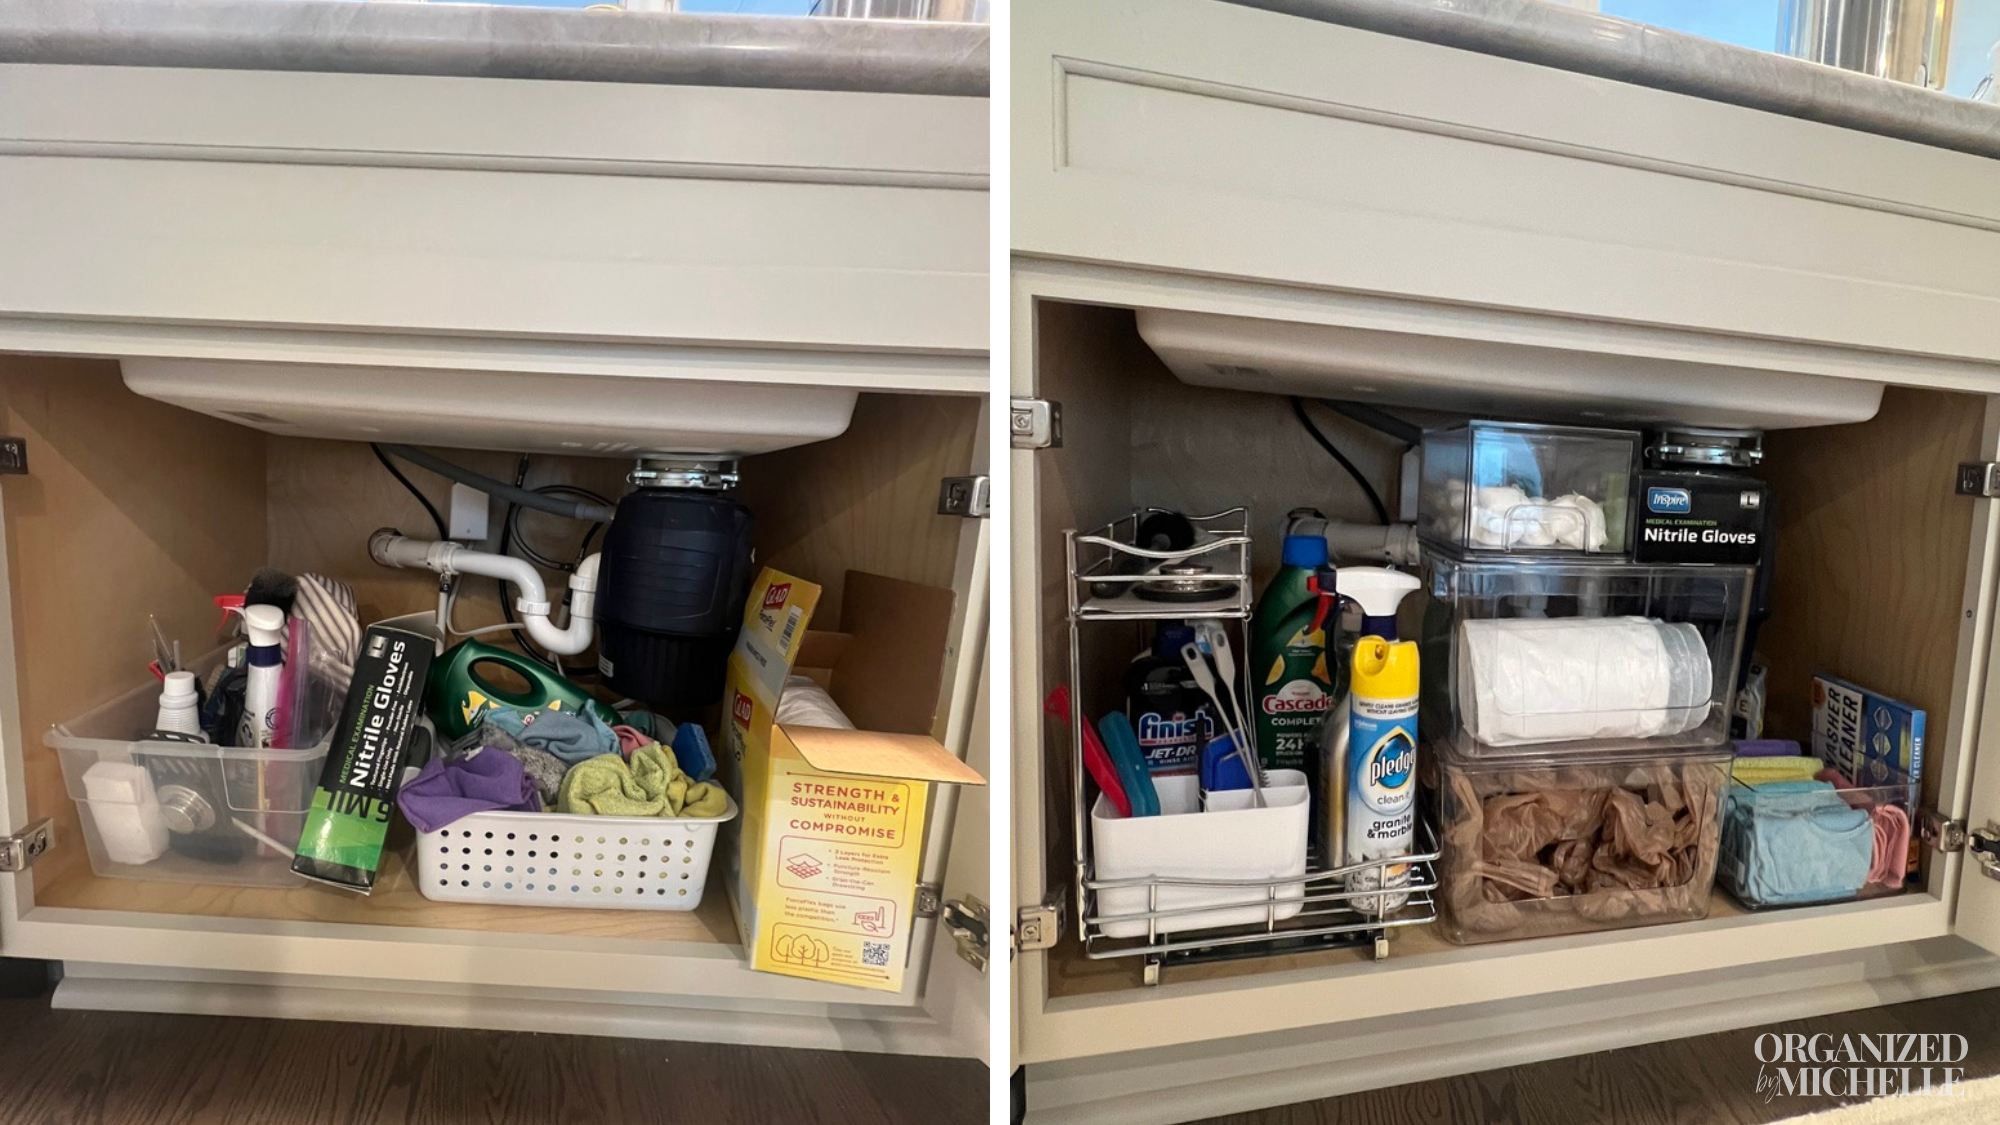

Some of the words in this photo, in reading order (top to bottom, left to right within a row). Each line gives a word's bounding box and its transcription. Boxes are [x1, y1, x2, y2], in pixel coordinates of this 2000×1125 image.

[1653, 494, 1685, 507] Inspire
[1746, 495, 1754, 506] L
[1644, 528, 1698, 542] Nitrile
[1701, 529, 1756, 544] Gloves
[766, 586, 788, 605] GLAD
[372, 643, 384, 651] L
[349, 714, 384, 788] Nitrile
[373, 641, 406, 709] Gloves
[735, 694, 751, 721] GLAD
[1139, 709, 1214, 740] finish
[1271, 717, 1322, 726] COMPLET
[339, 744, 358, 784] MEDICAL
[352, 684, 375, 743] EXAMINATION
[1145, 745, 1197, 759] JET-DR
[1914, 737, 1922, 768] CLEANER
[793, 782, 885, 801] STRENGTH
[891, 793, 900, 803] &
[1377, 794, 1404, 804] clean
[322, 786, 372, 819] MIL
[791, 796, 900, 816] SUSTAINABILITY
[823, 813, 865, 822] WITHOUT
[1373, 814, 1411, 831] granite
[789, 819, 896, 839] COMPROMISE
[840, 850, 859, 858] Layers
[851, 857, 884, 865] Protection
[818, 901, 834, 909] bags
